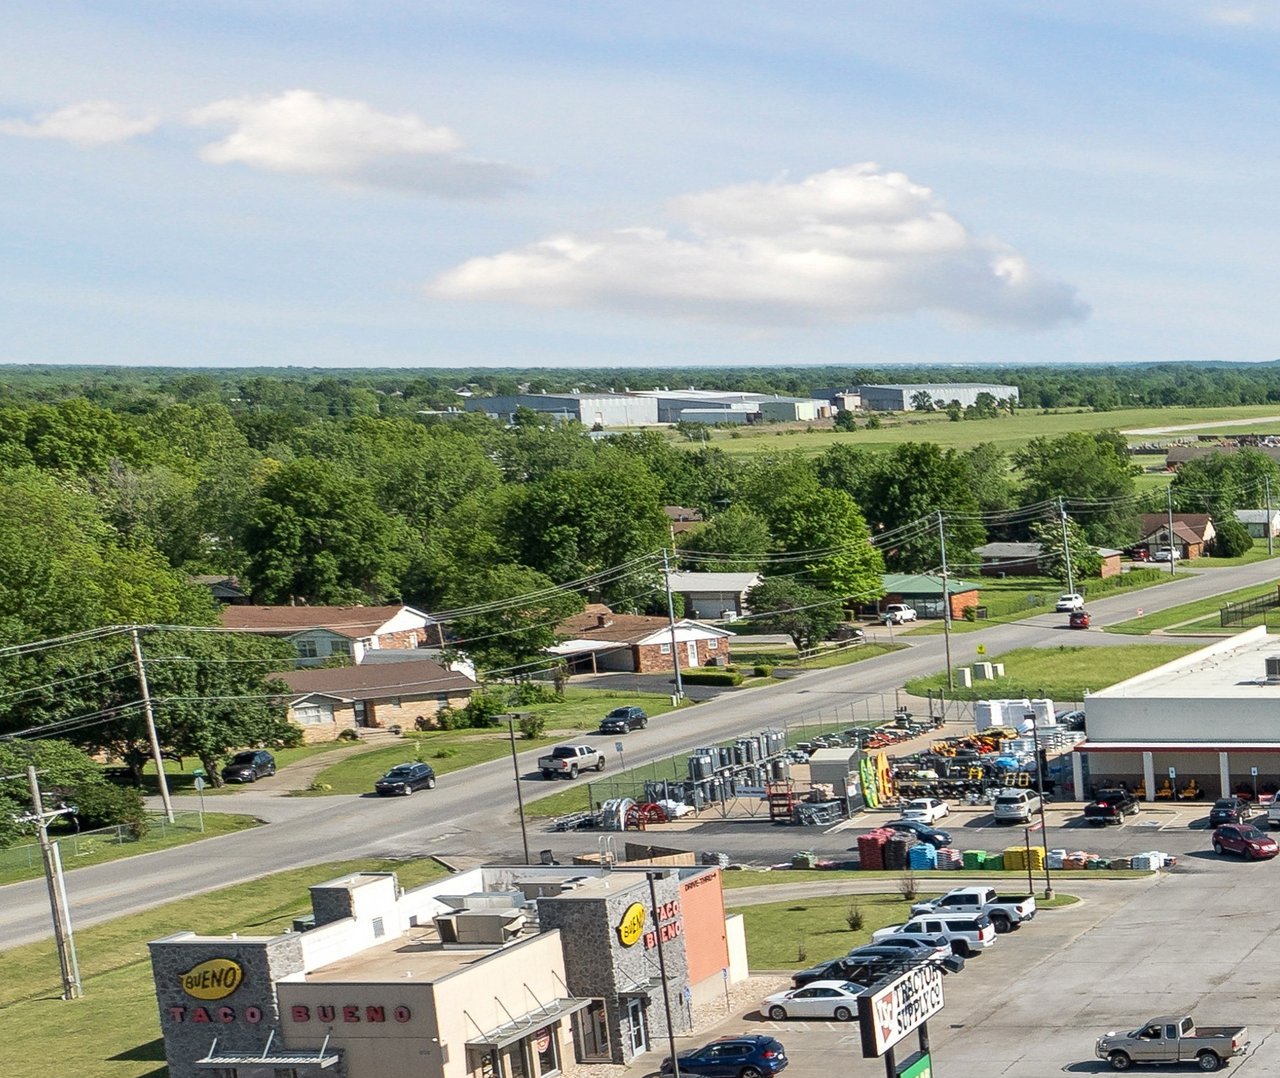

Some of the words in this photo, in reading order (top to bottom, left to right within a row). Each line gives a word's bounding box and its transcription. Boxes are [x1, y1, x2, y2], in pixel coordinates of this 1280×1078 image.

[185, 967, 236, 990] BUENO
[894, 965, 939, 1008] TRACTOR
[170, 1005, 263, 1024] TACO
[292, 1005, 411, 1024] BUENO
[897, 992, 929, 1034] SUPPLY
